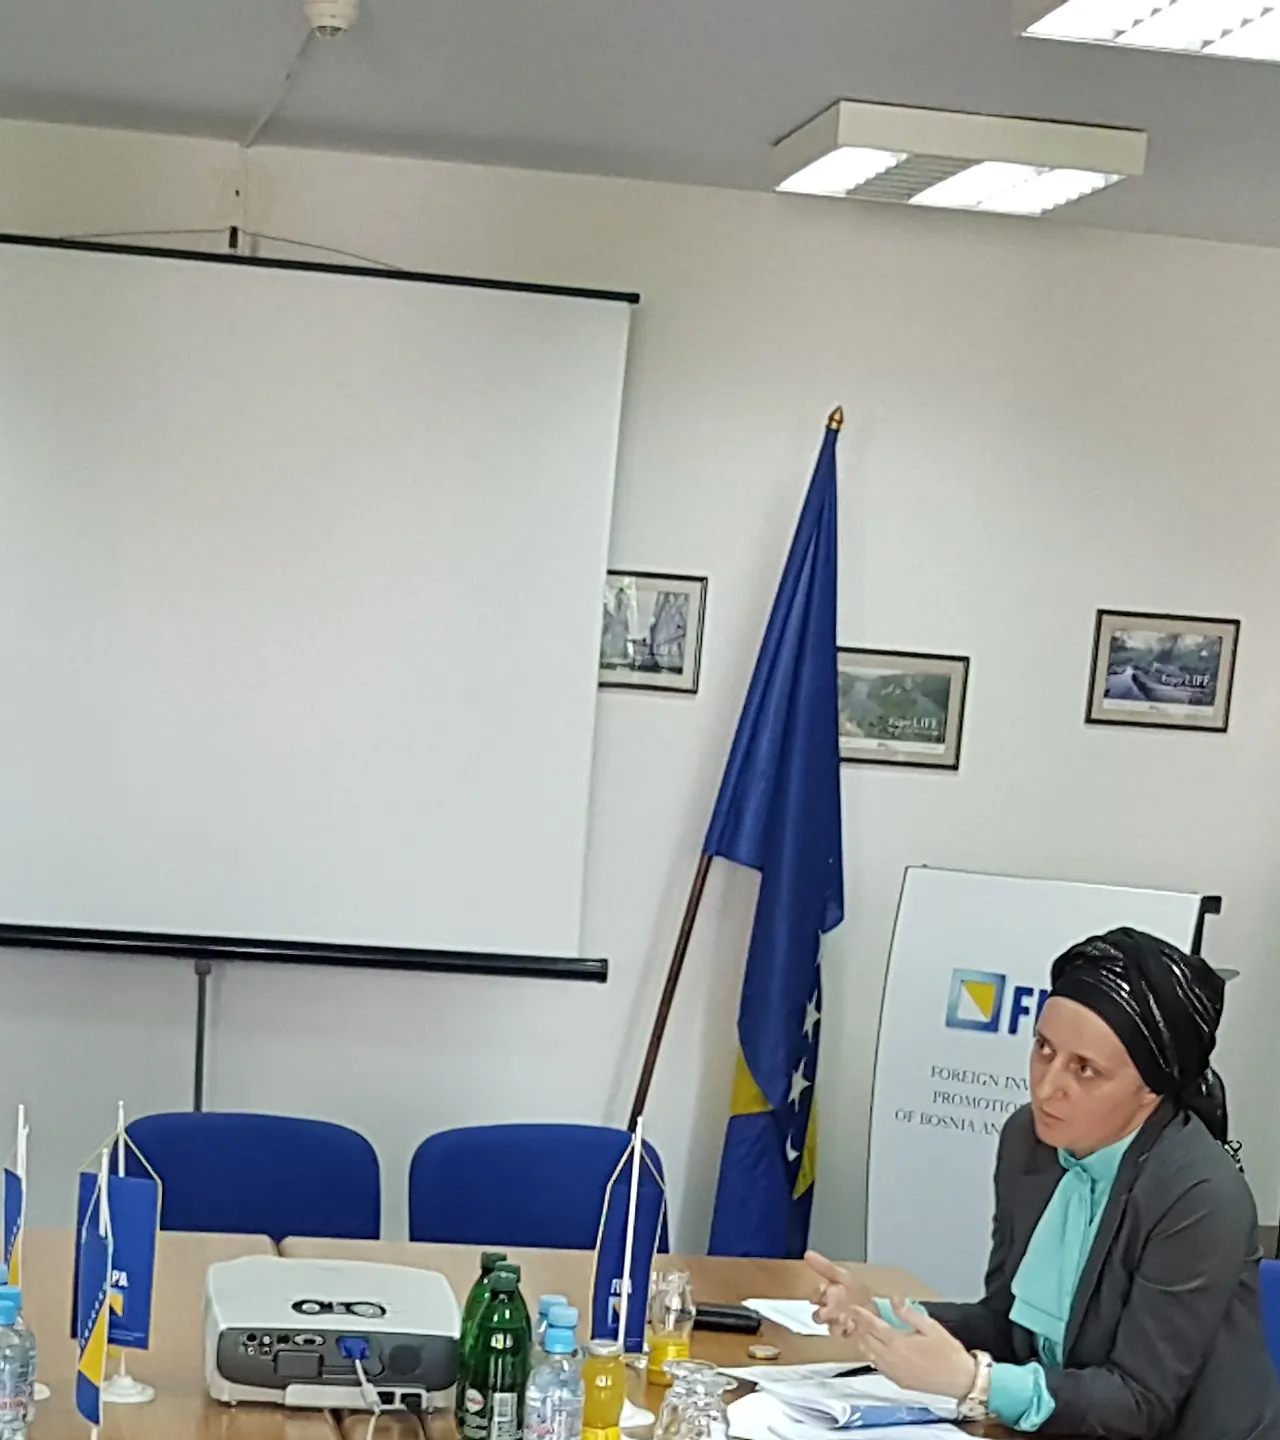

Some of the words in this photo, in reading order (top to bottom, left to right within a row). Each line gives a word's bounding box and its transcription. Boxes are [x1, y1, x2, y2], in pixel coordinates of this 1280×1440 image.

[930, 1065, 999, 1087] FOREIGN
[932, 1090, 1024, 1114] PROMOTIO
[895, 1108, 914, 1123] OF
[920, 1112, 975, 1133] BOSNIA
